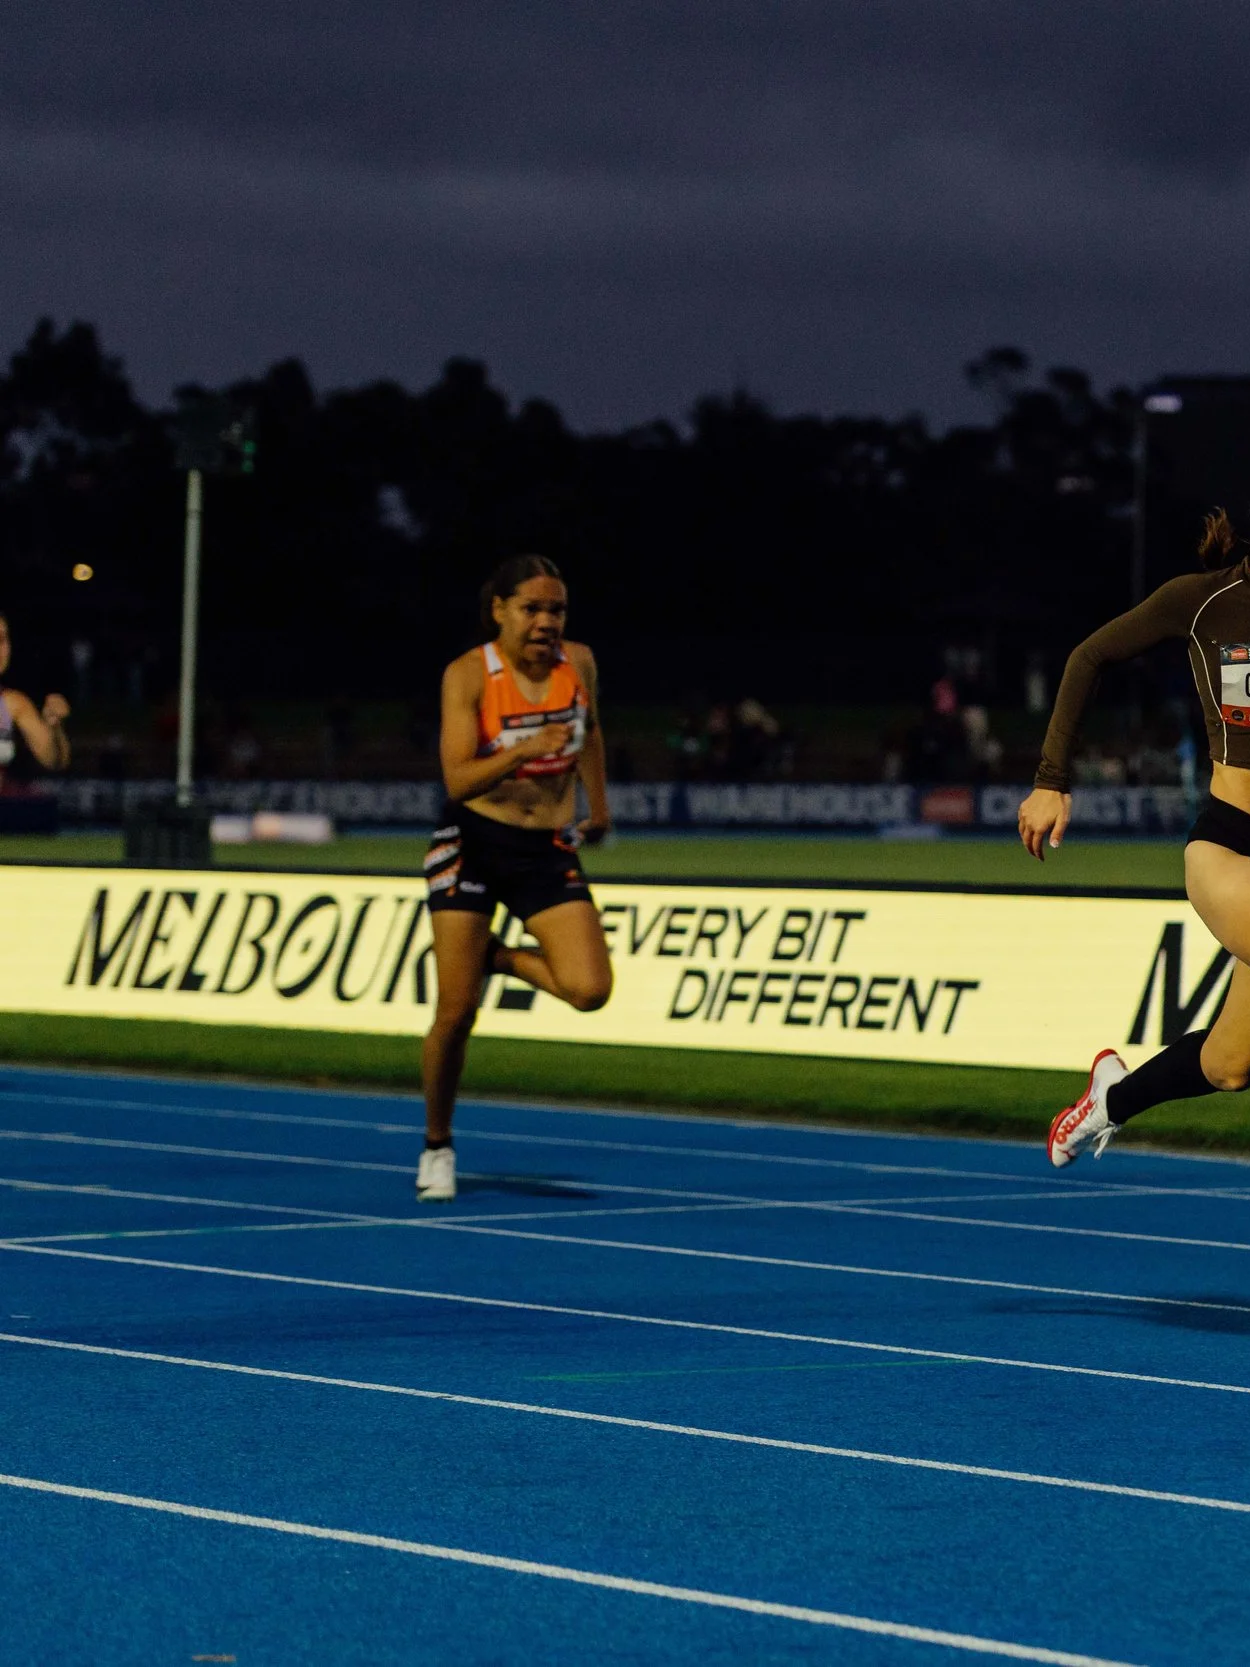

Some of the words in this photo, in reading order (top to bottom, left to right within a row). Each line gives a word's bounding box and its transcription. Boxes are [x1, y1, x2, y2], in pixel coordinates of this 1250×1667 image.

[66, 887, 541, 1011] MELBOUR
[771, 909, 866, 963] BIT
[668, 969, 981, 1035] DIFFERENT
